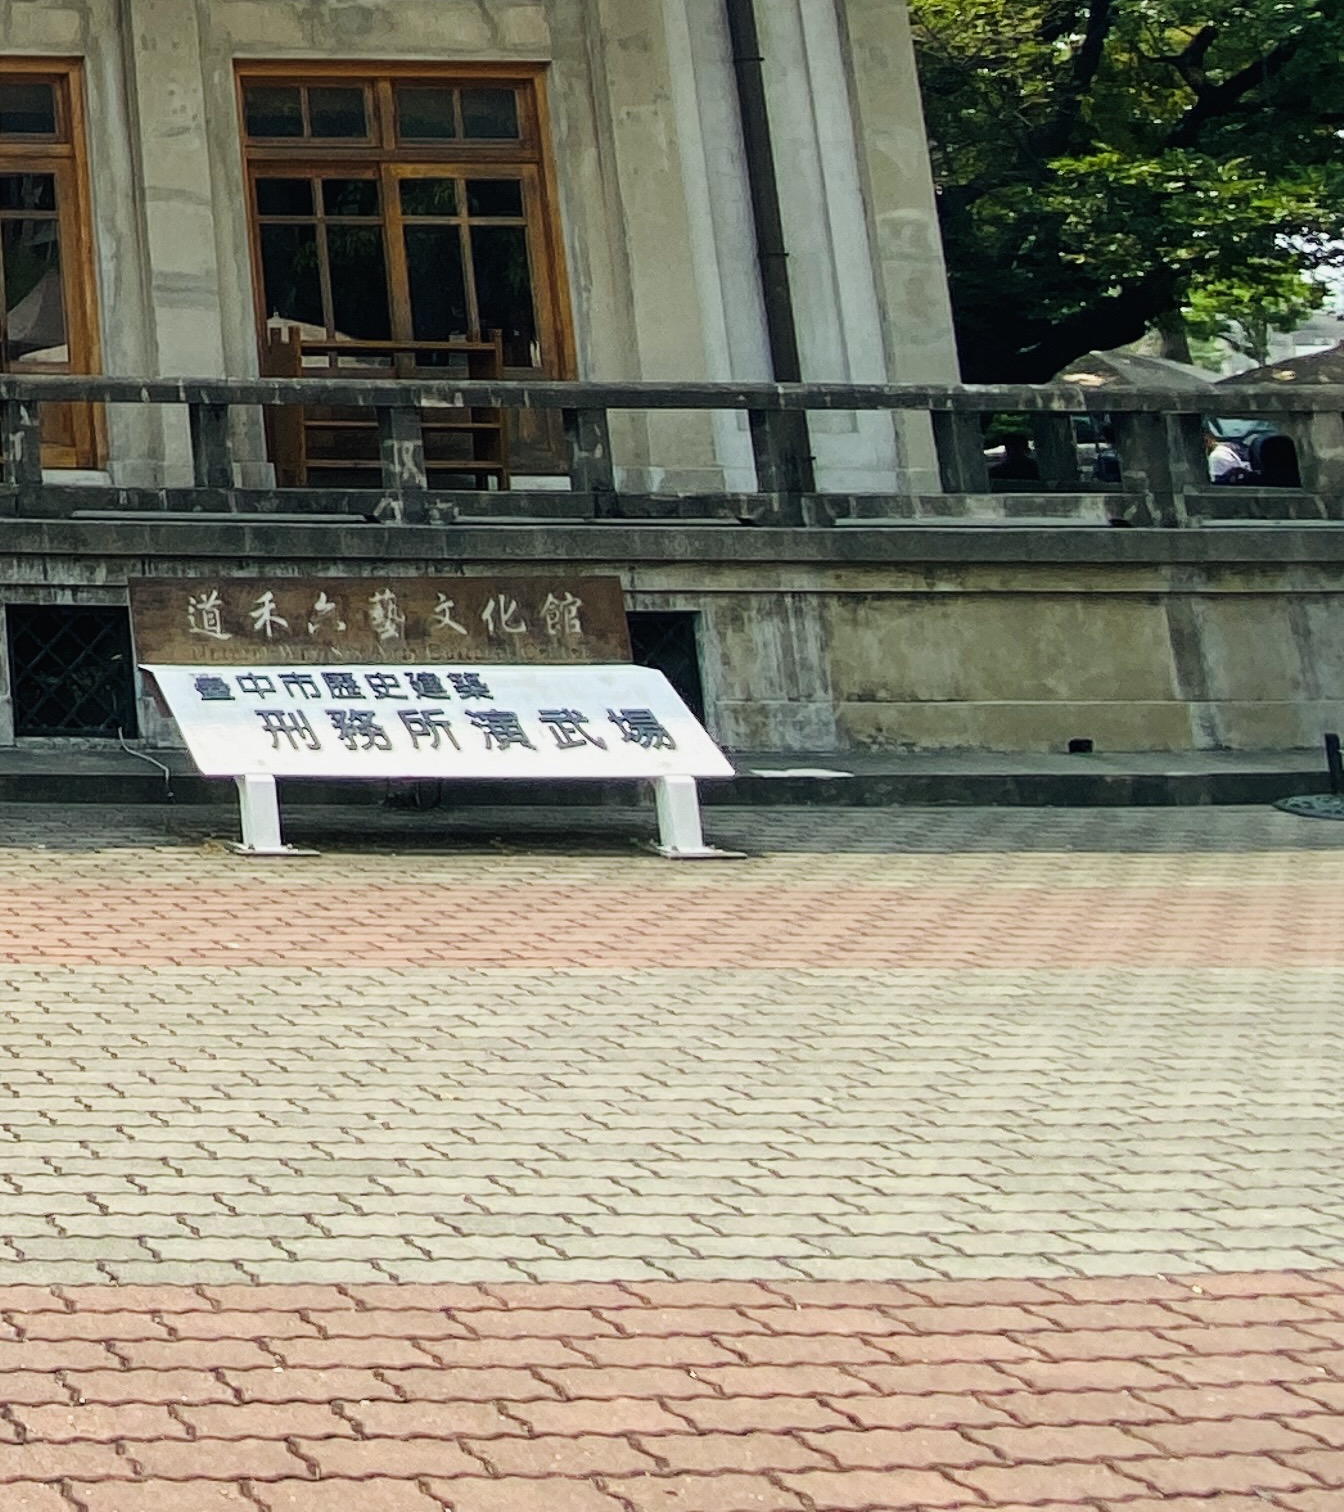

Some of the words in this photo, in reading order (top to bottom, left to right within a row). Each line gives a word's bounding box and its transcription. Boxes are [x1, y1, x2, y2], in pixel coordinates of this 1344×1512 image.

[188, 588, 583, 642] 道禾六藝文化館
[191, 672, 495, 701] 臺中市歷史建築
[254, 708, 678, 752] 刑務所演武場
